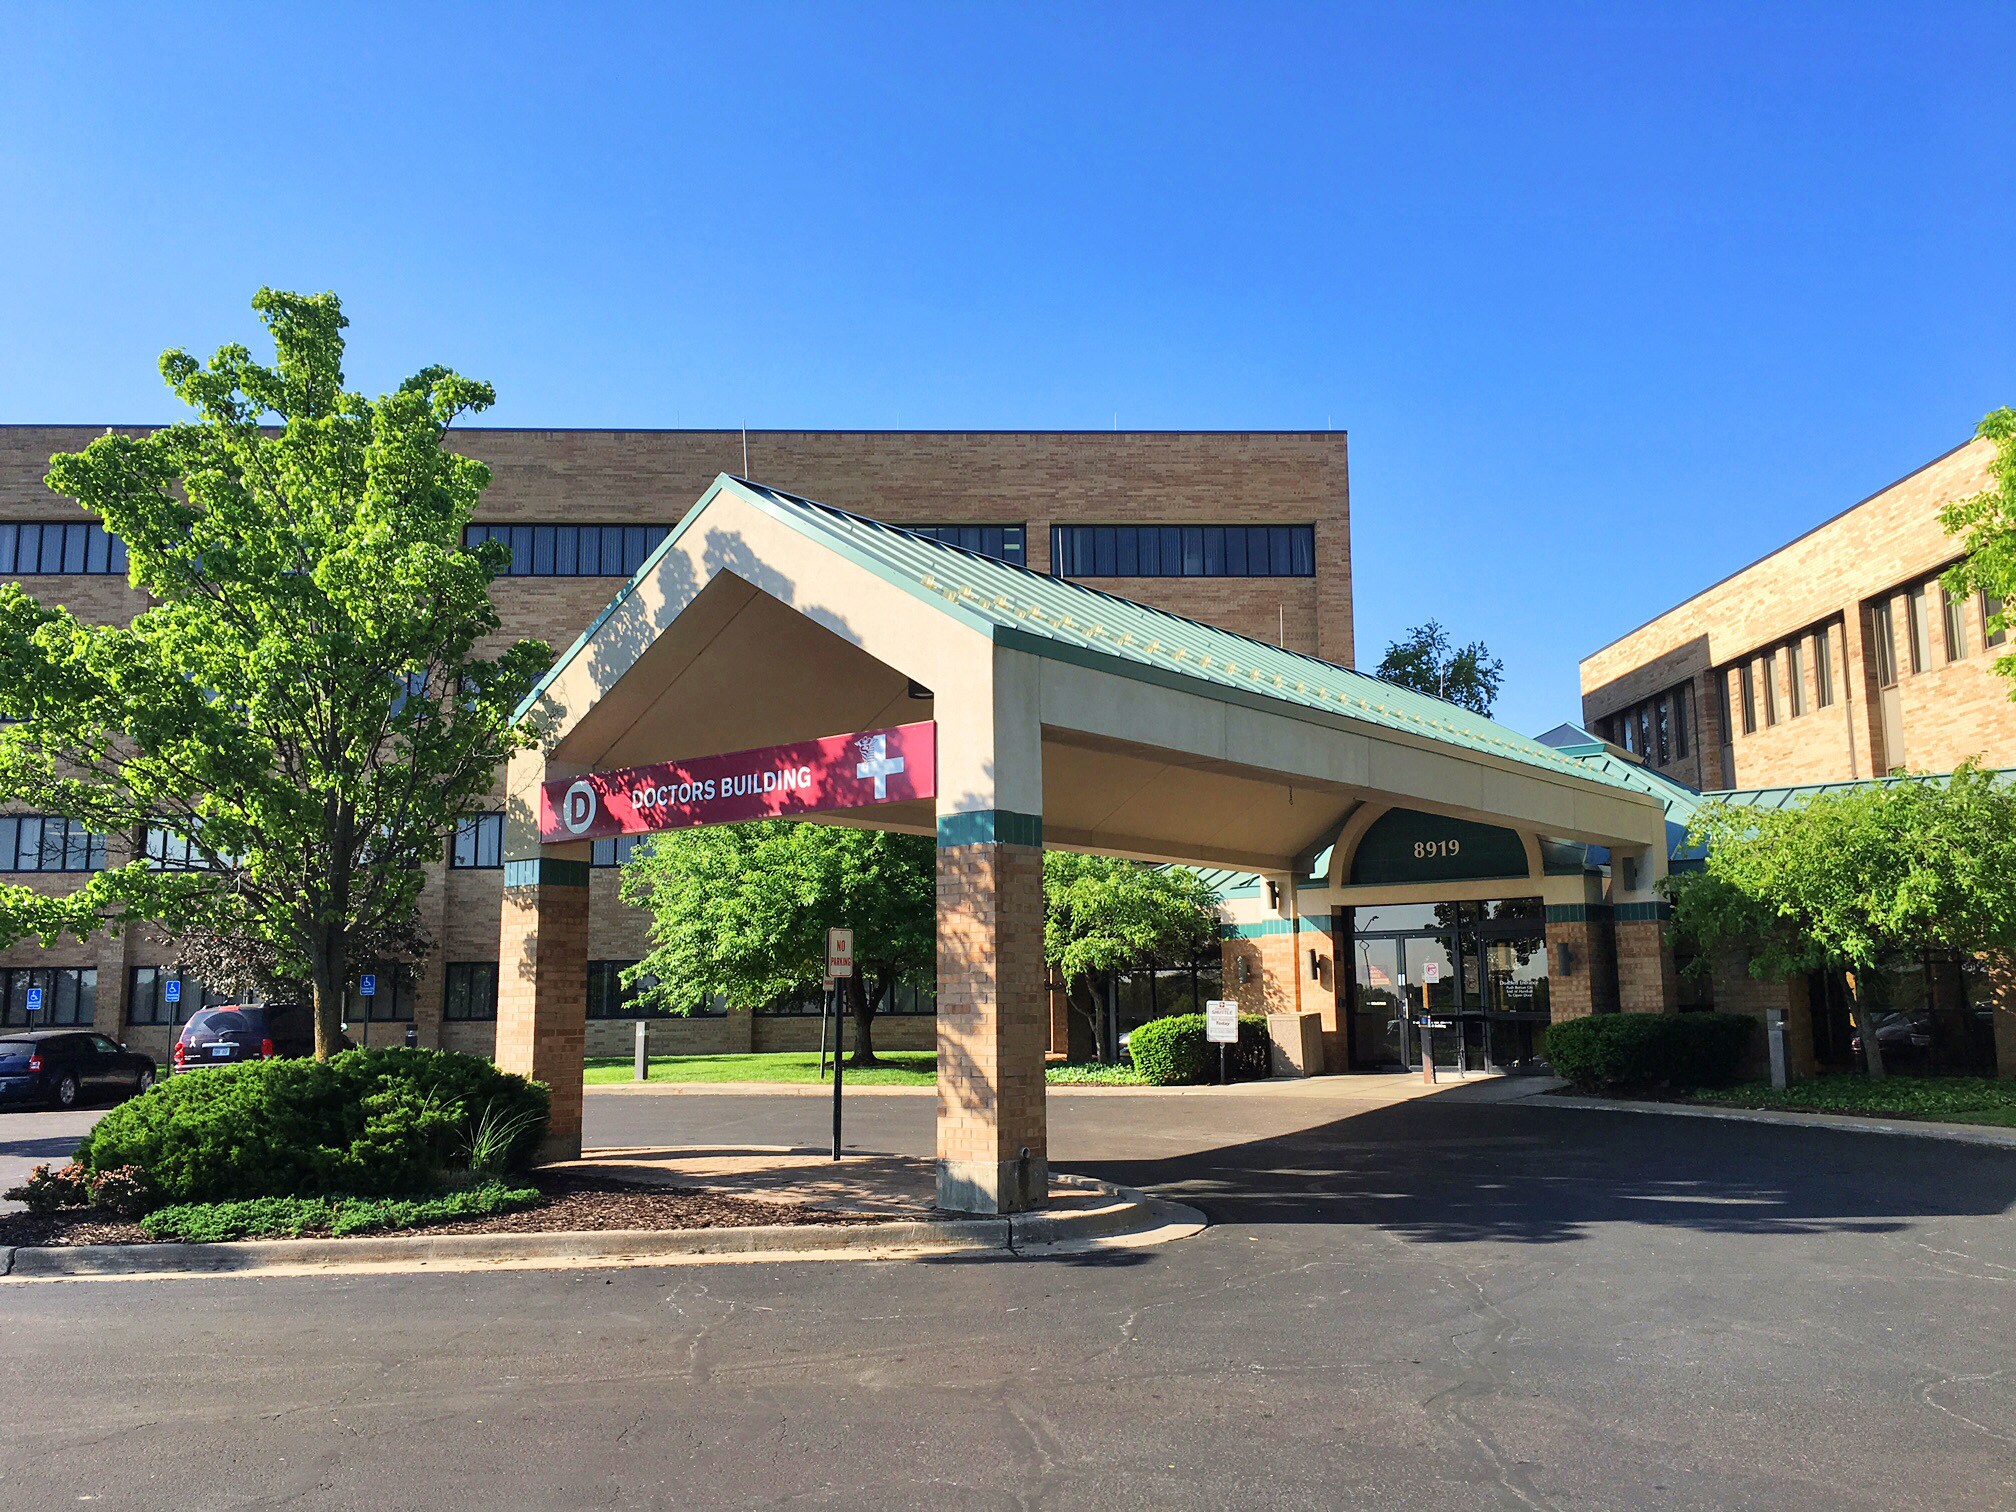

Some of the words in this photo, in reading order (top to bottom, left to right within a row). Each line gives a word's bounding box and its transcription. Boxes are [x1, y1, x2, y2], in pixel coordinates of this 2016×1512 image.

[632, 779, 716, 809] DOCTORS
[721, 766, 811, 797] BUILDING
[571, 791, 590, 825] D
[1413, 839, 1460, 858] 8919
[836, 940, 846, 952] NO
[830, 957, 851, 966] PARKING
